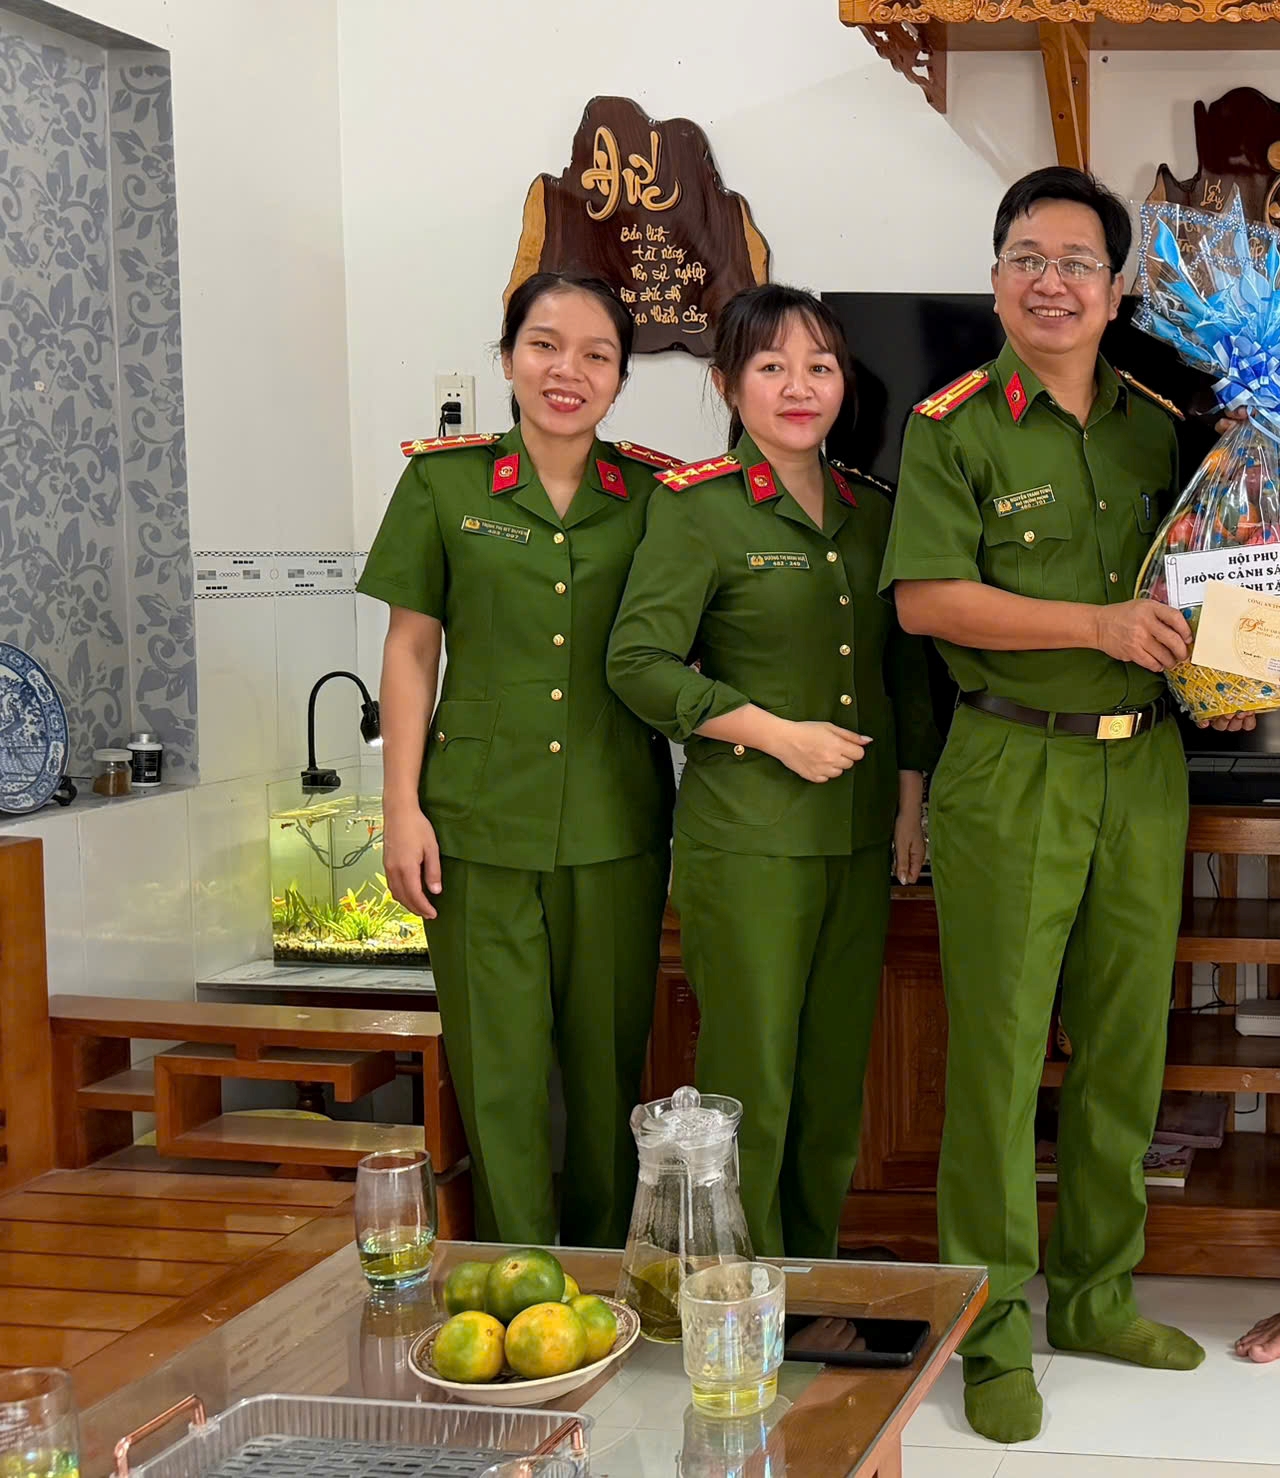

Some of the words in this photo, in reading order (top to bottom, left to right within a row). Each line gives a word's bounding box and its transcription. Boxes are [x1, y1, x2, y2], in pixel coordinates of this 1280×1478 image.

[581, 126, 681, 221] Đức
[620, 223, 643, 242] Bản
[631, 244, 659, 262] tài
[661, 244, 688, 265] năng
[652, 263, 670, 282] sự
[629, 308, 648, 325] ạo
[650, 304, 679, 324] thành
[682, 305, 708, 334] công
[1228, 552, 1250, 565] HỘI
[1253, 551, 1278, 564] PHỤ
[1184, 571, 1225, 585] PHÒNG
[1227, 565, 1264, 580] CẢNH
